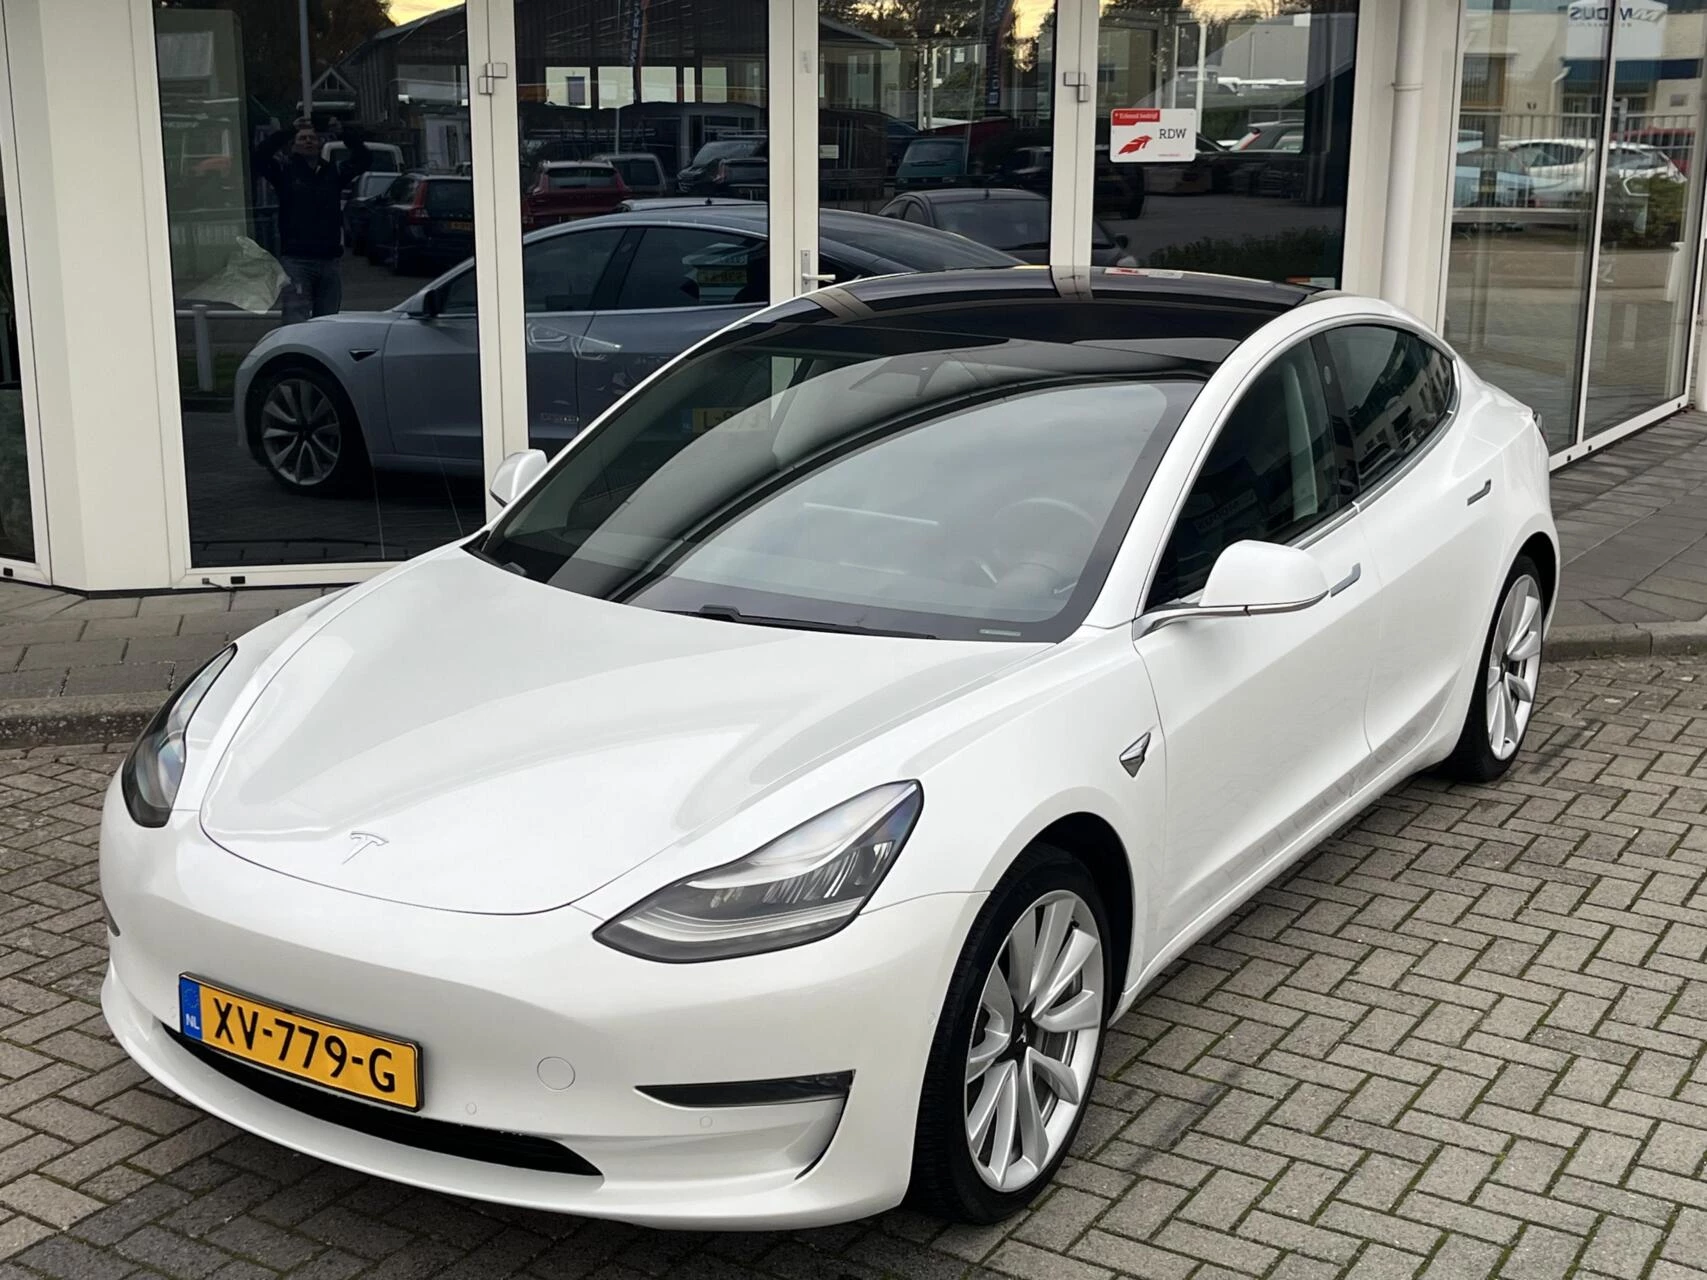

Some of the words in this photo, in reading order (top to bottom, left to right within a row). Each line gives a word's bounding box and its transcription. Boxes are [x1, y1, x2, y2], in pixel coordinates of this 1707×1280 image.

[1158, 128, 1187, 140] RDW
[185, 1013, 201, 1031] NL
[213, 997, 396, 1094] XV-779-G
